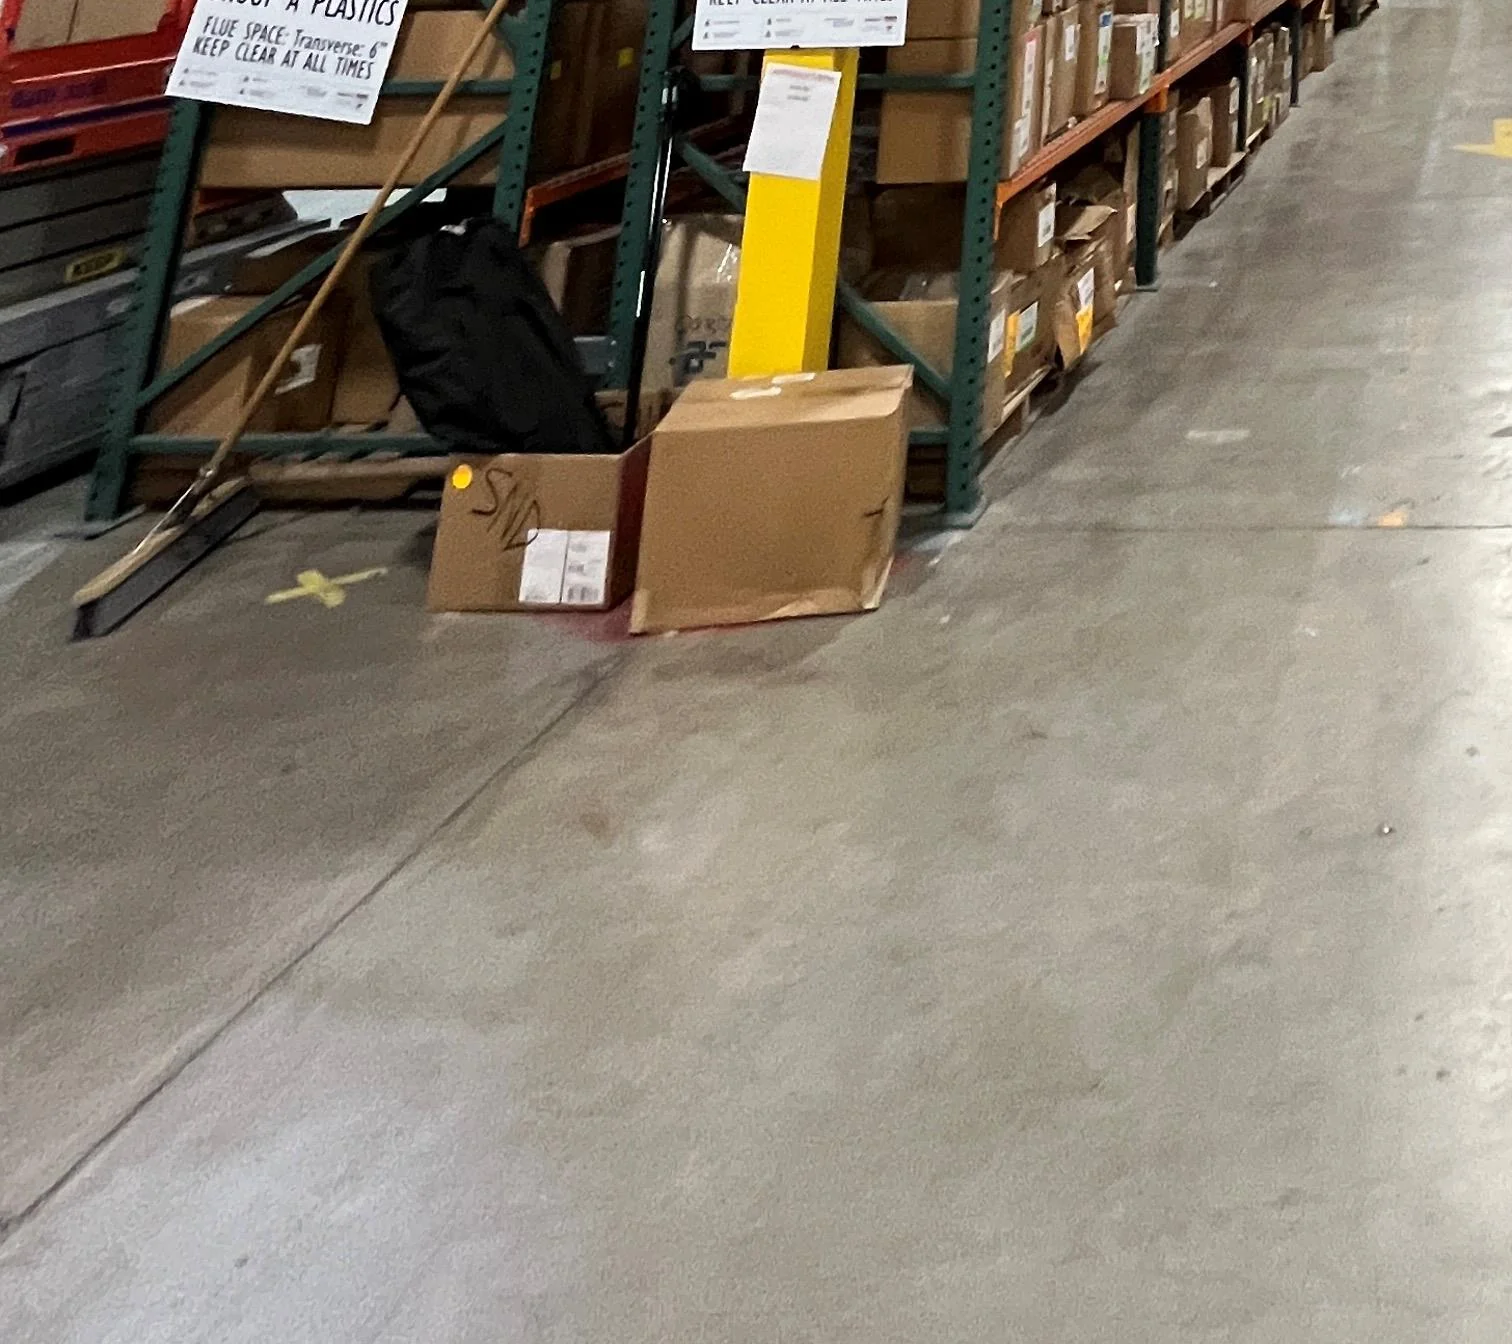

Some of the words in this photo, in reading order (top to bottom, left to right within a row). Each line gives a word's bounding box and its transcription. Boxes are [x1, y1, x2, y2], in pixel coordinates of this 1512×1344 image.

[203, 16, 240, 38] FLUE
[193, 36, 228, 58] KEEP
[235, 42, 277, 64] CLEAR
[281, 49, 300, 68] AT
[303, 52, 325, 73] ALL
[335, 56, 374, 80] TIMES
